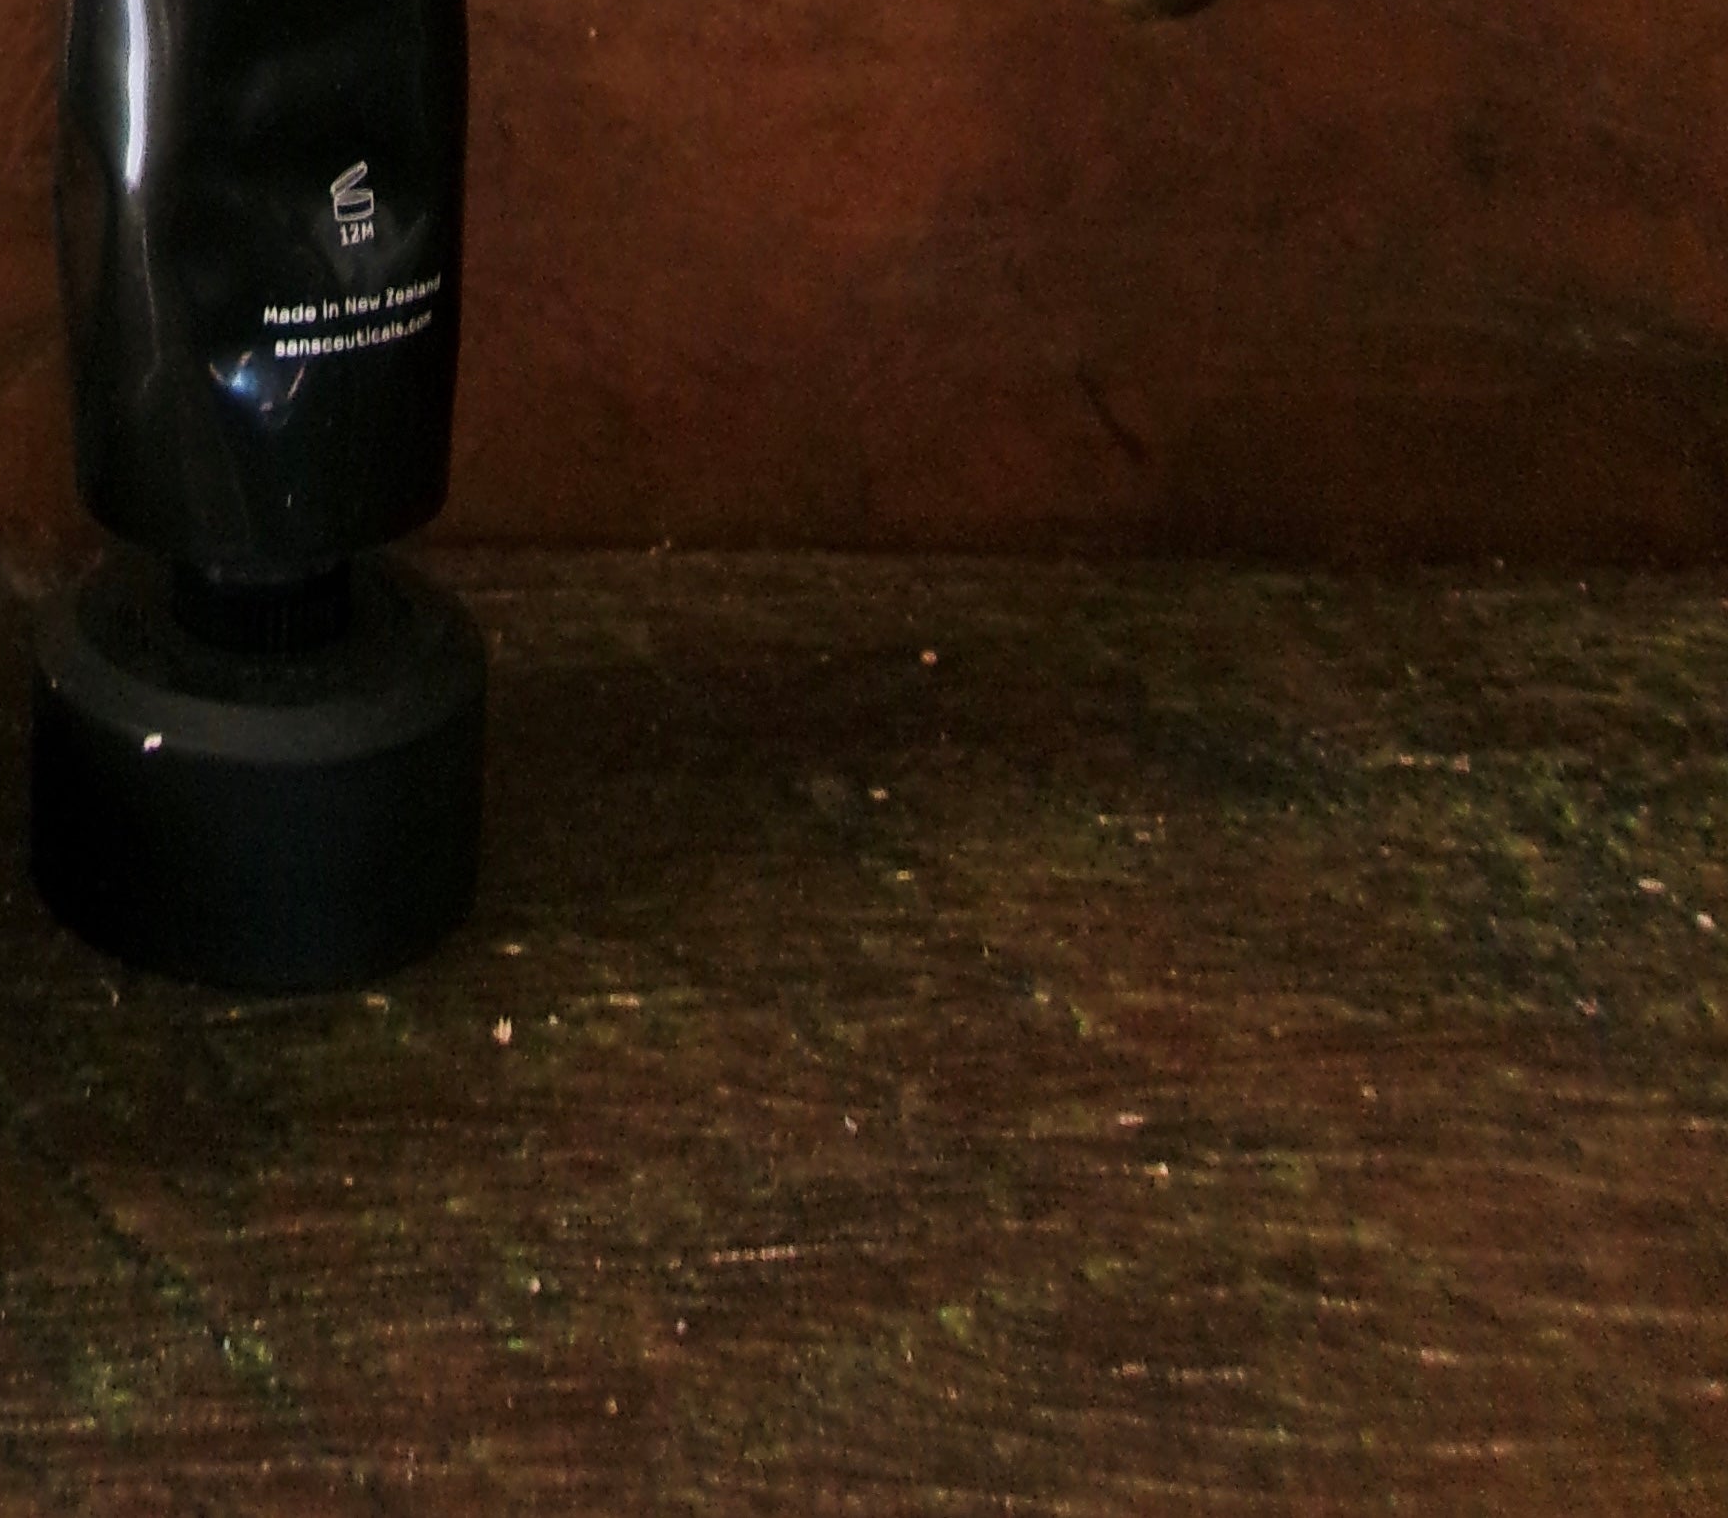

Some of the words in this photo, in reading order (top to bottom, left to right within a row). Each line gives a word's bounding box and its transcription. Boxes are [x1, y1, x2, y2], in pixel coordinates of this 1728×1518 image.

[339, 220, 375, 247] 12M
[263, 302, 317, 326] Made
[323, 298, 339, 322] in
[345, 292, 381, 315] New
[385, 271, 442, 308] Zealand
